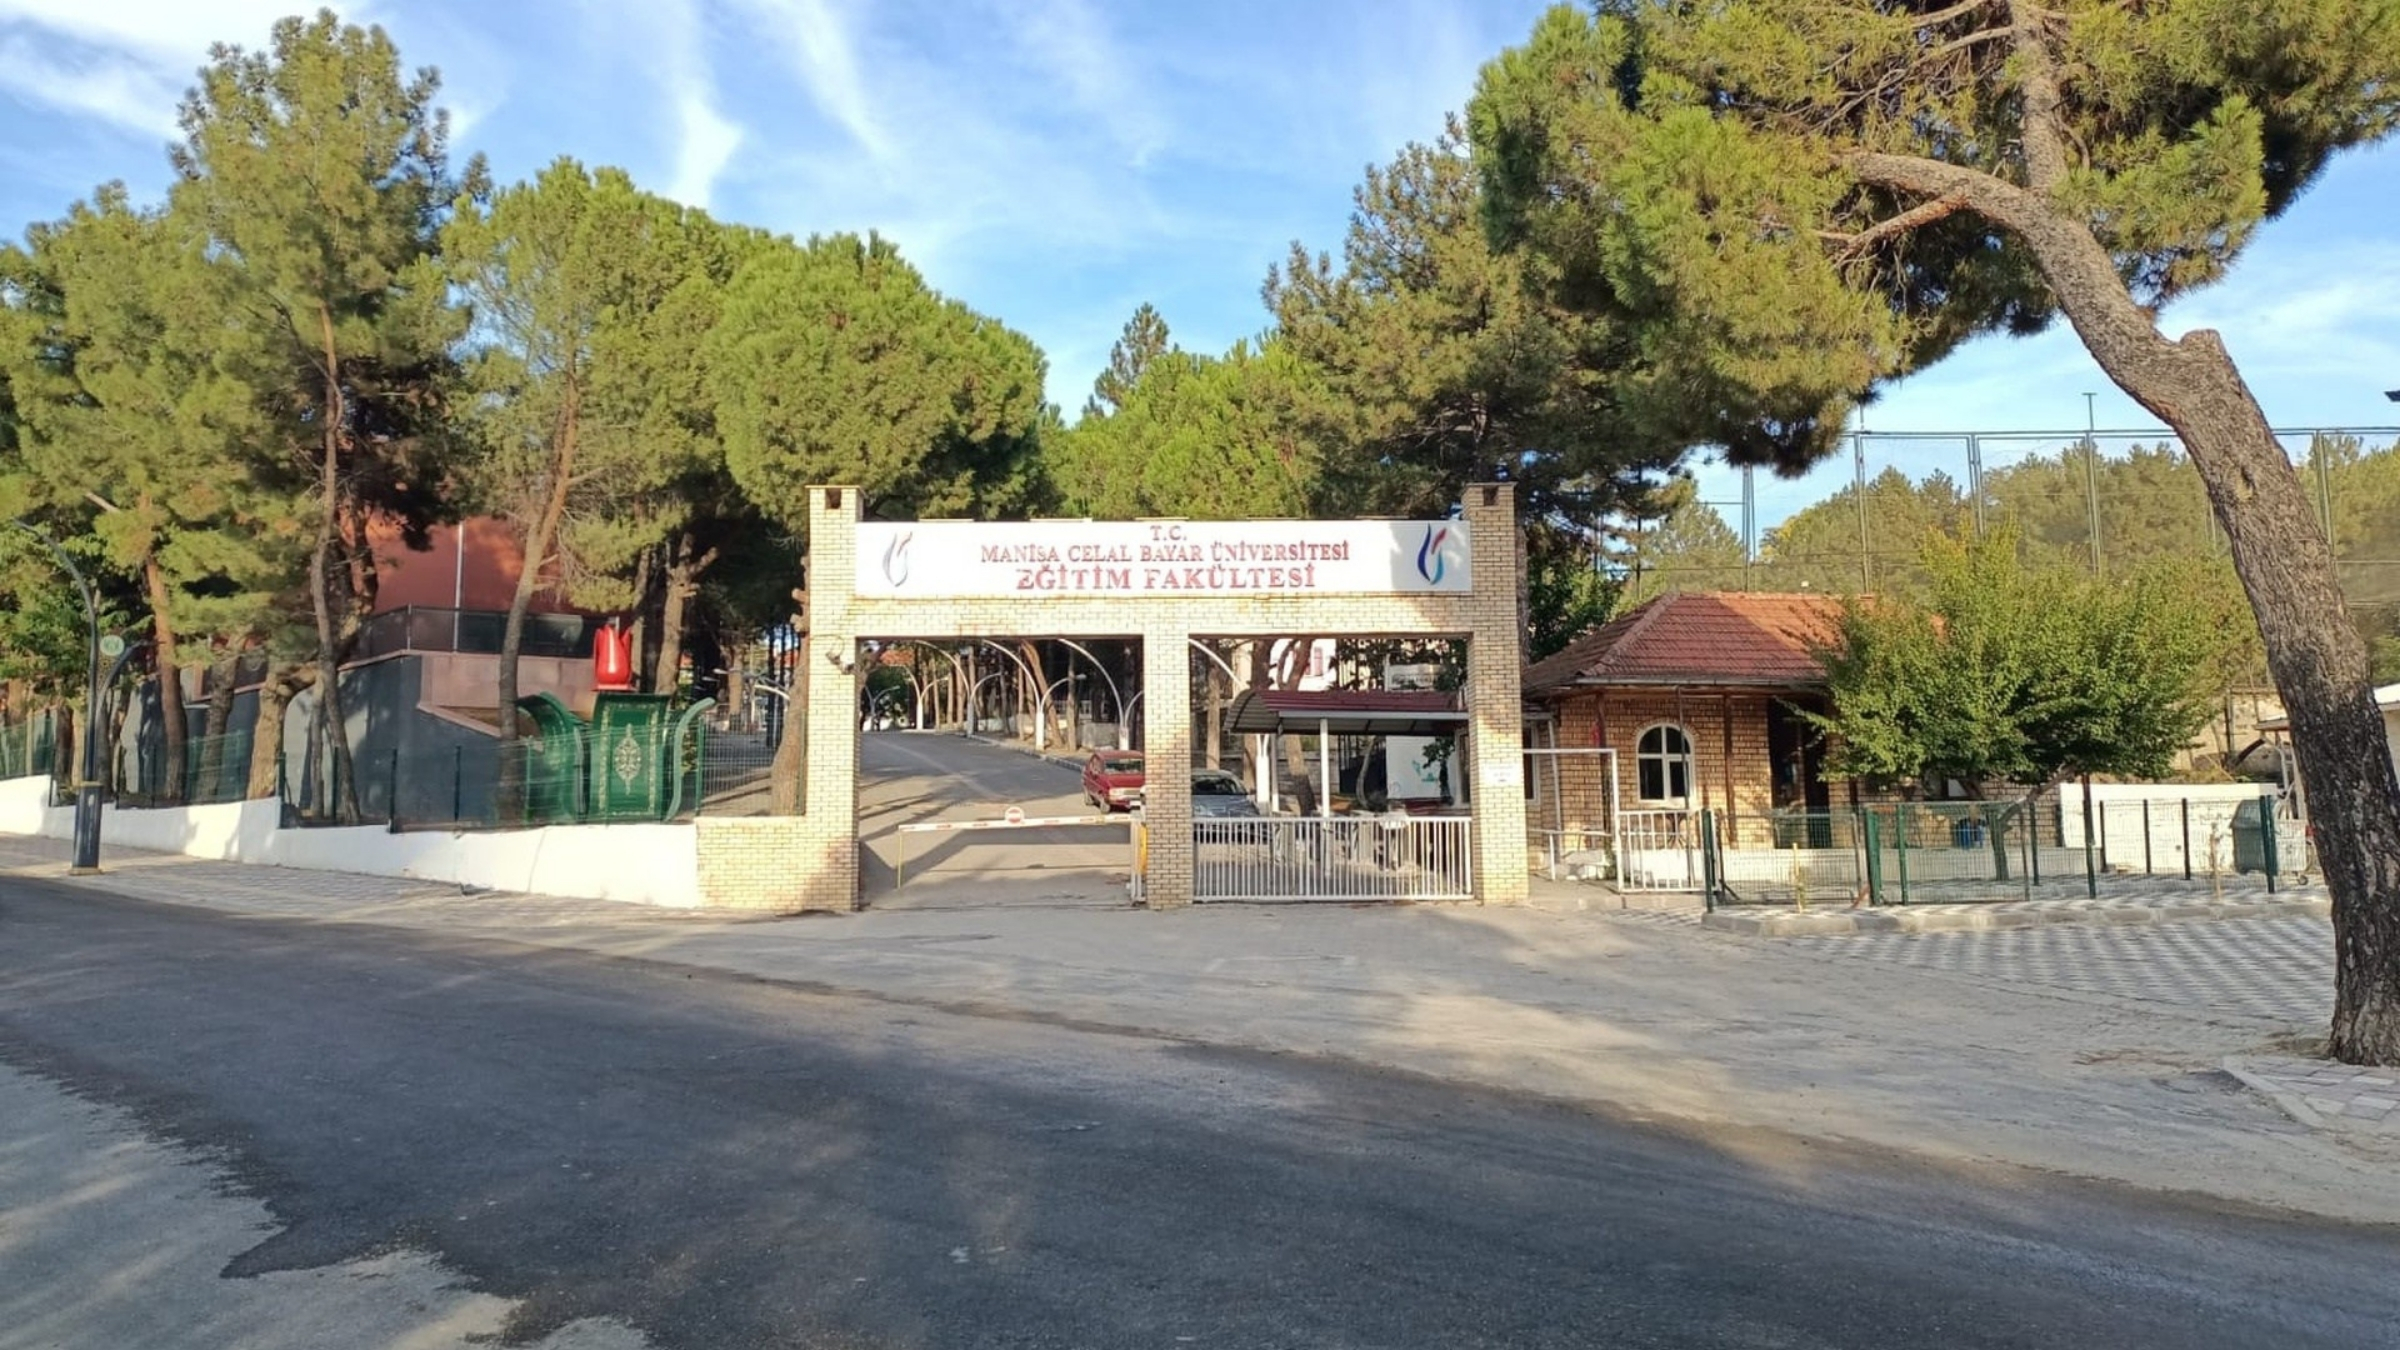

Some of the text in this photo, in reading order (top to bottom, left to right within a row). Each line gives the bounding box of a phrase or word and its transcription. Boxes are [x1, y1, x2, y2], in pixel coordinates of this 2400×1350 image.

[1150, 525, 1187, 541] T.C.
[981, 540, 1350, 563] MANİSA CELAL BAYAR ÜNİVERSİTESİ
[1144, 563, 1316, 589] FAKÜLTESİ
